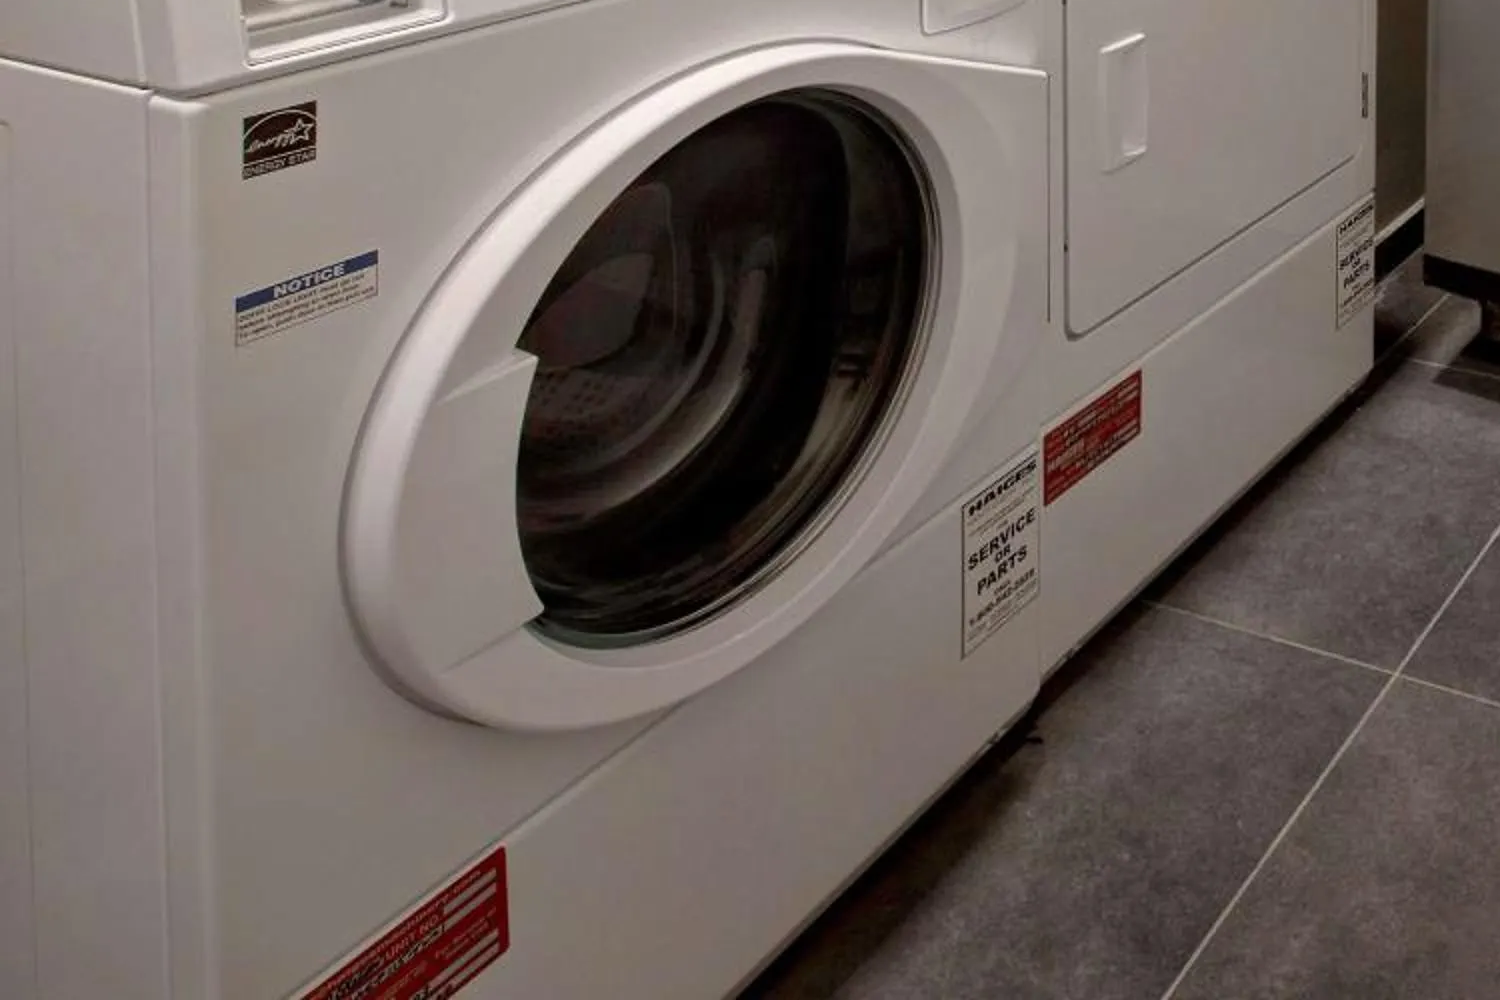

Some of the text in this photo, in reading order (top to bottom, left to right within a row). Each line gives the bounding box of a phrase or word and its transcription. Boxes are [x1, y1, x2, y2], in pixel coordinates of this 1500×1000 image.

[273, 263, 345, 298] NOTICE
[968, 507, 1035, 571] SERVICE
[995, 543, 1011, 564] OR
[976, 545, 1028, 596] PARTS
